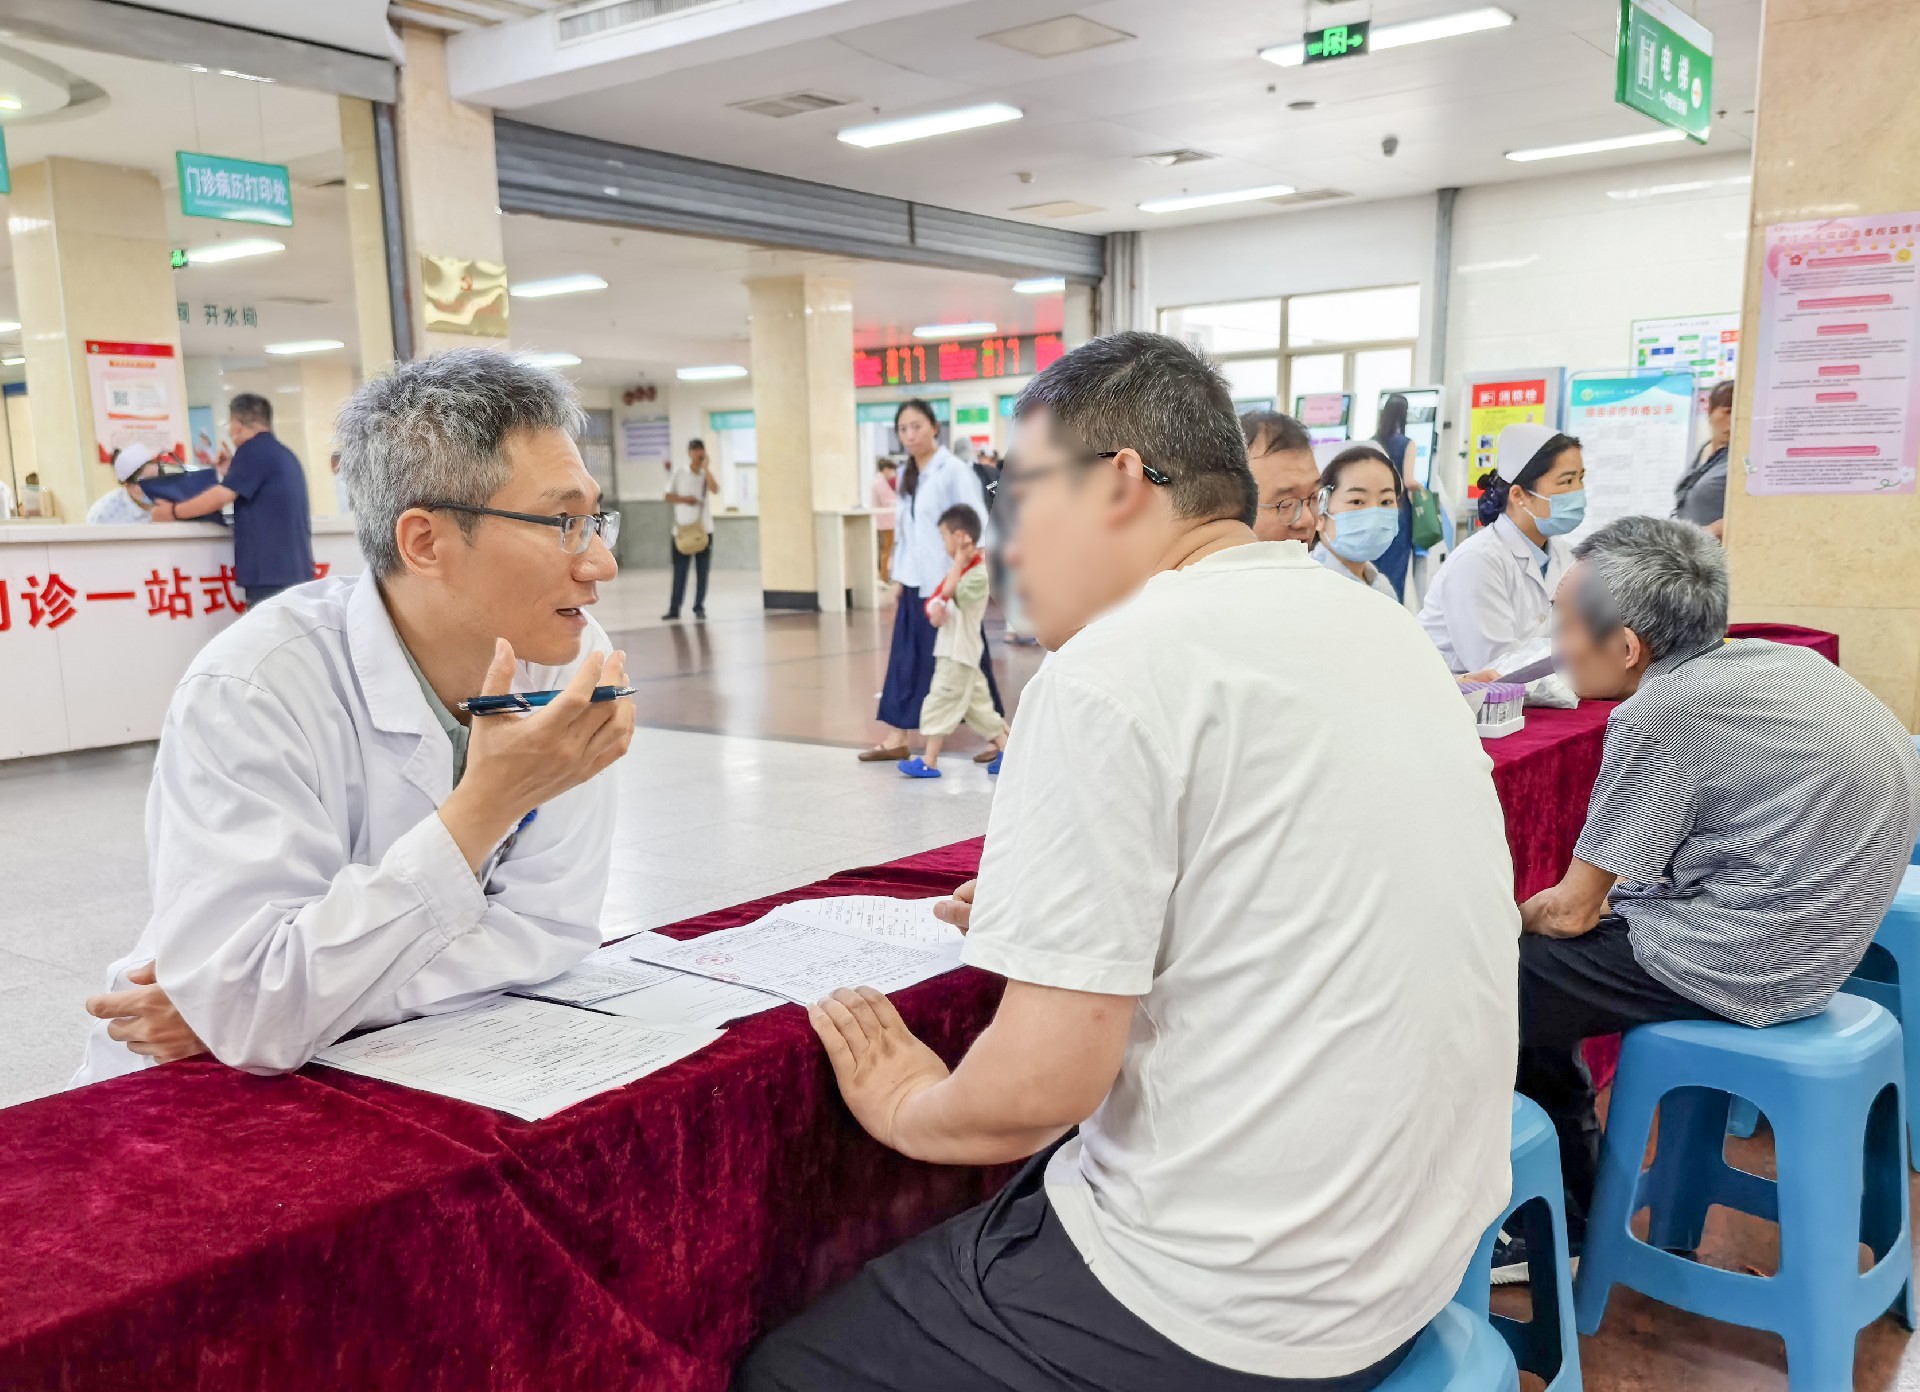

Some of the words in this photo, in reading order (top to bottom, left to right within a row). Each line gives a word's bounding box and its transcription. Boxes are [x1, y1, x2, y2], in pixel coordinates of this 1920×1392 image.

[186, 166, 288, 205] 门诊病历打印处
[204, 304, 257, 328] 开水间
[0, 562, 331, 631] 诊一站式
